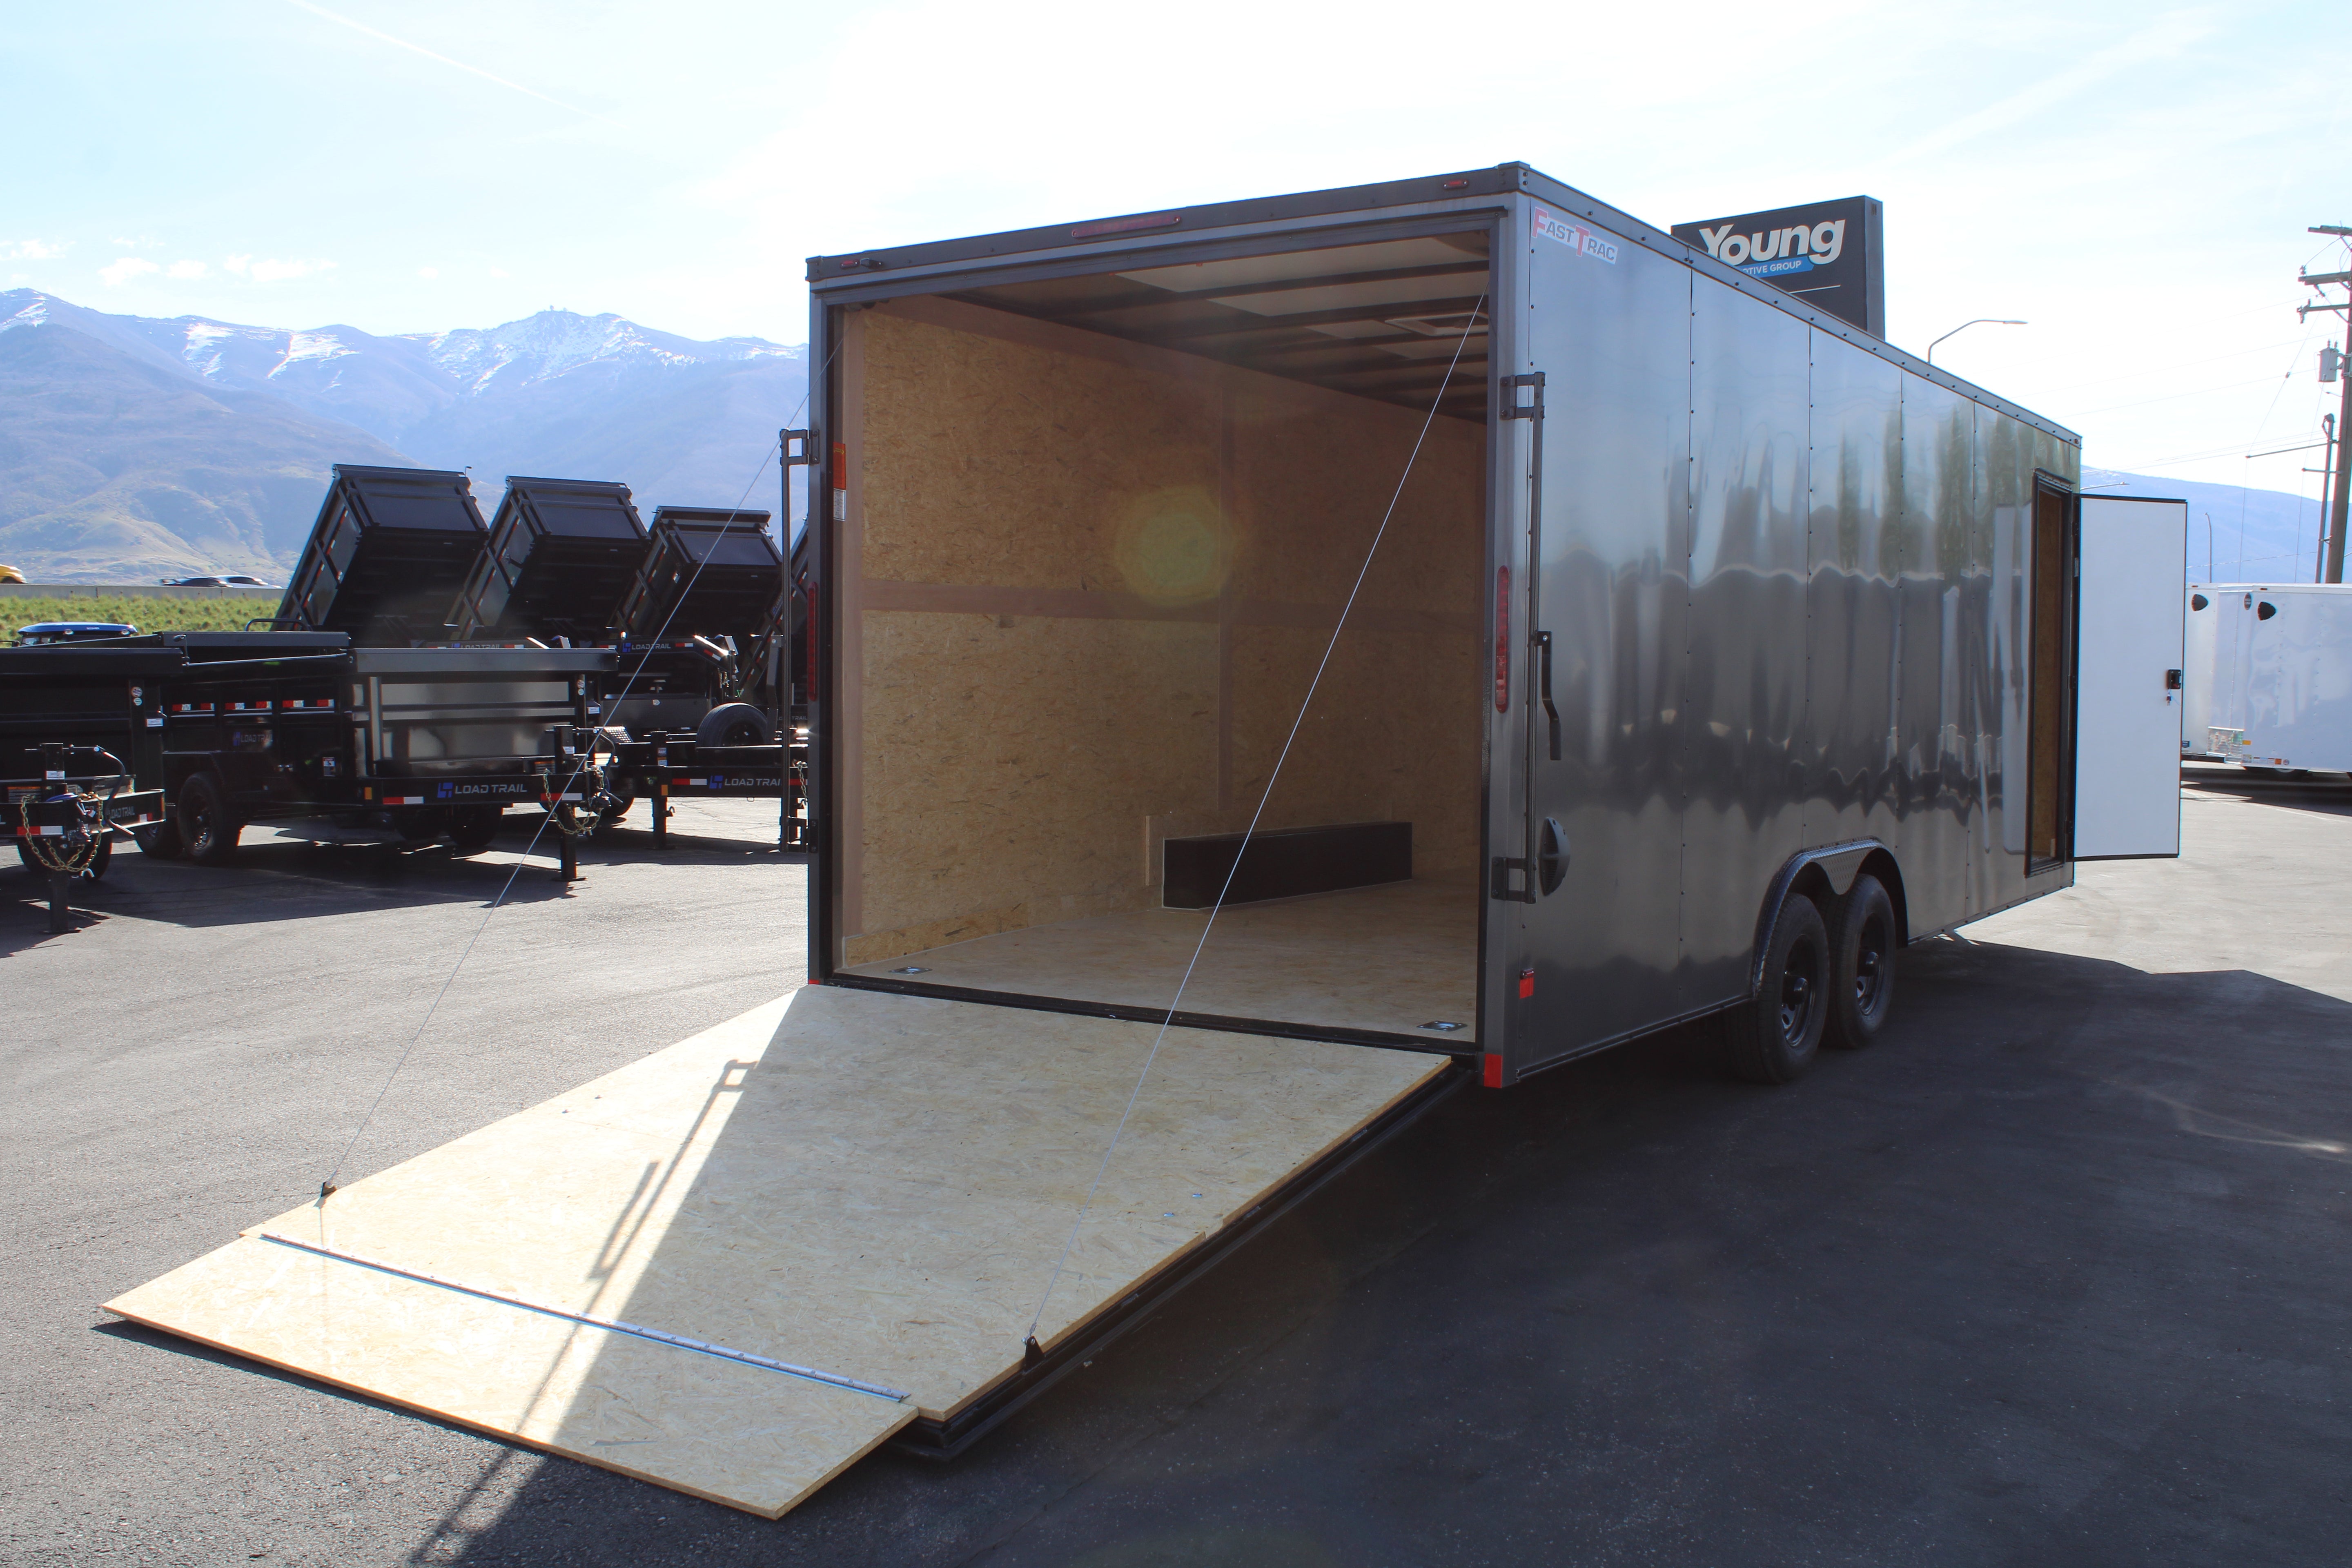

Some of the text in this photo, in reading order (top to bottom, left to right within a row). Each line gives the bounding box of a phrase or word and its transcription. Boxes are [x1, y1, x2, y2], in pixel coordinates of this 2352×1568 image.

[1699, 219, 1846, 266] Young
[1770, 261, 1802, 271] GROUP
[455, 784, 527, 794] LOAD TRAIL
